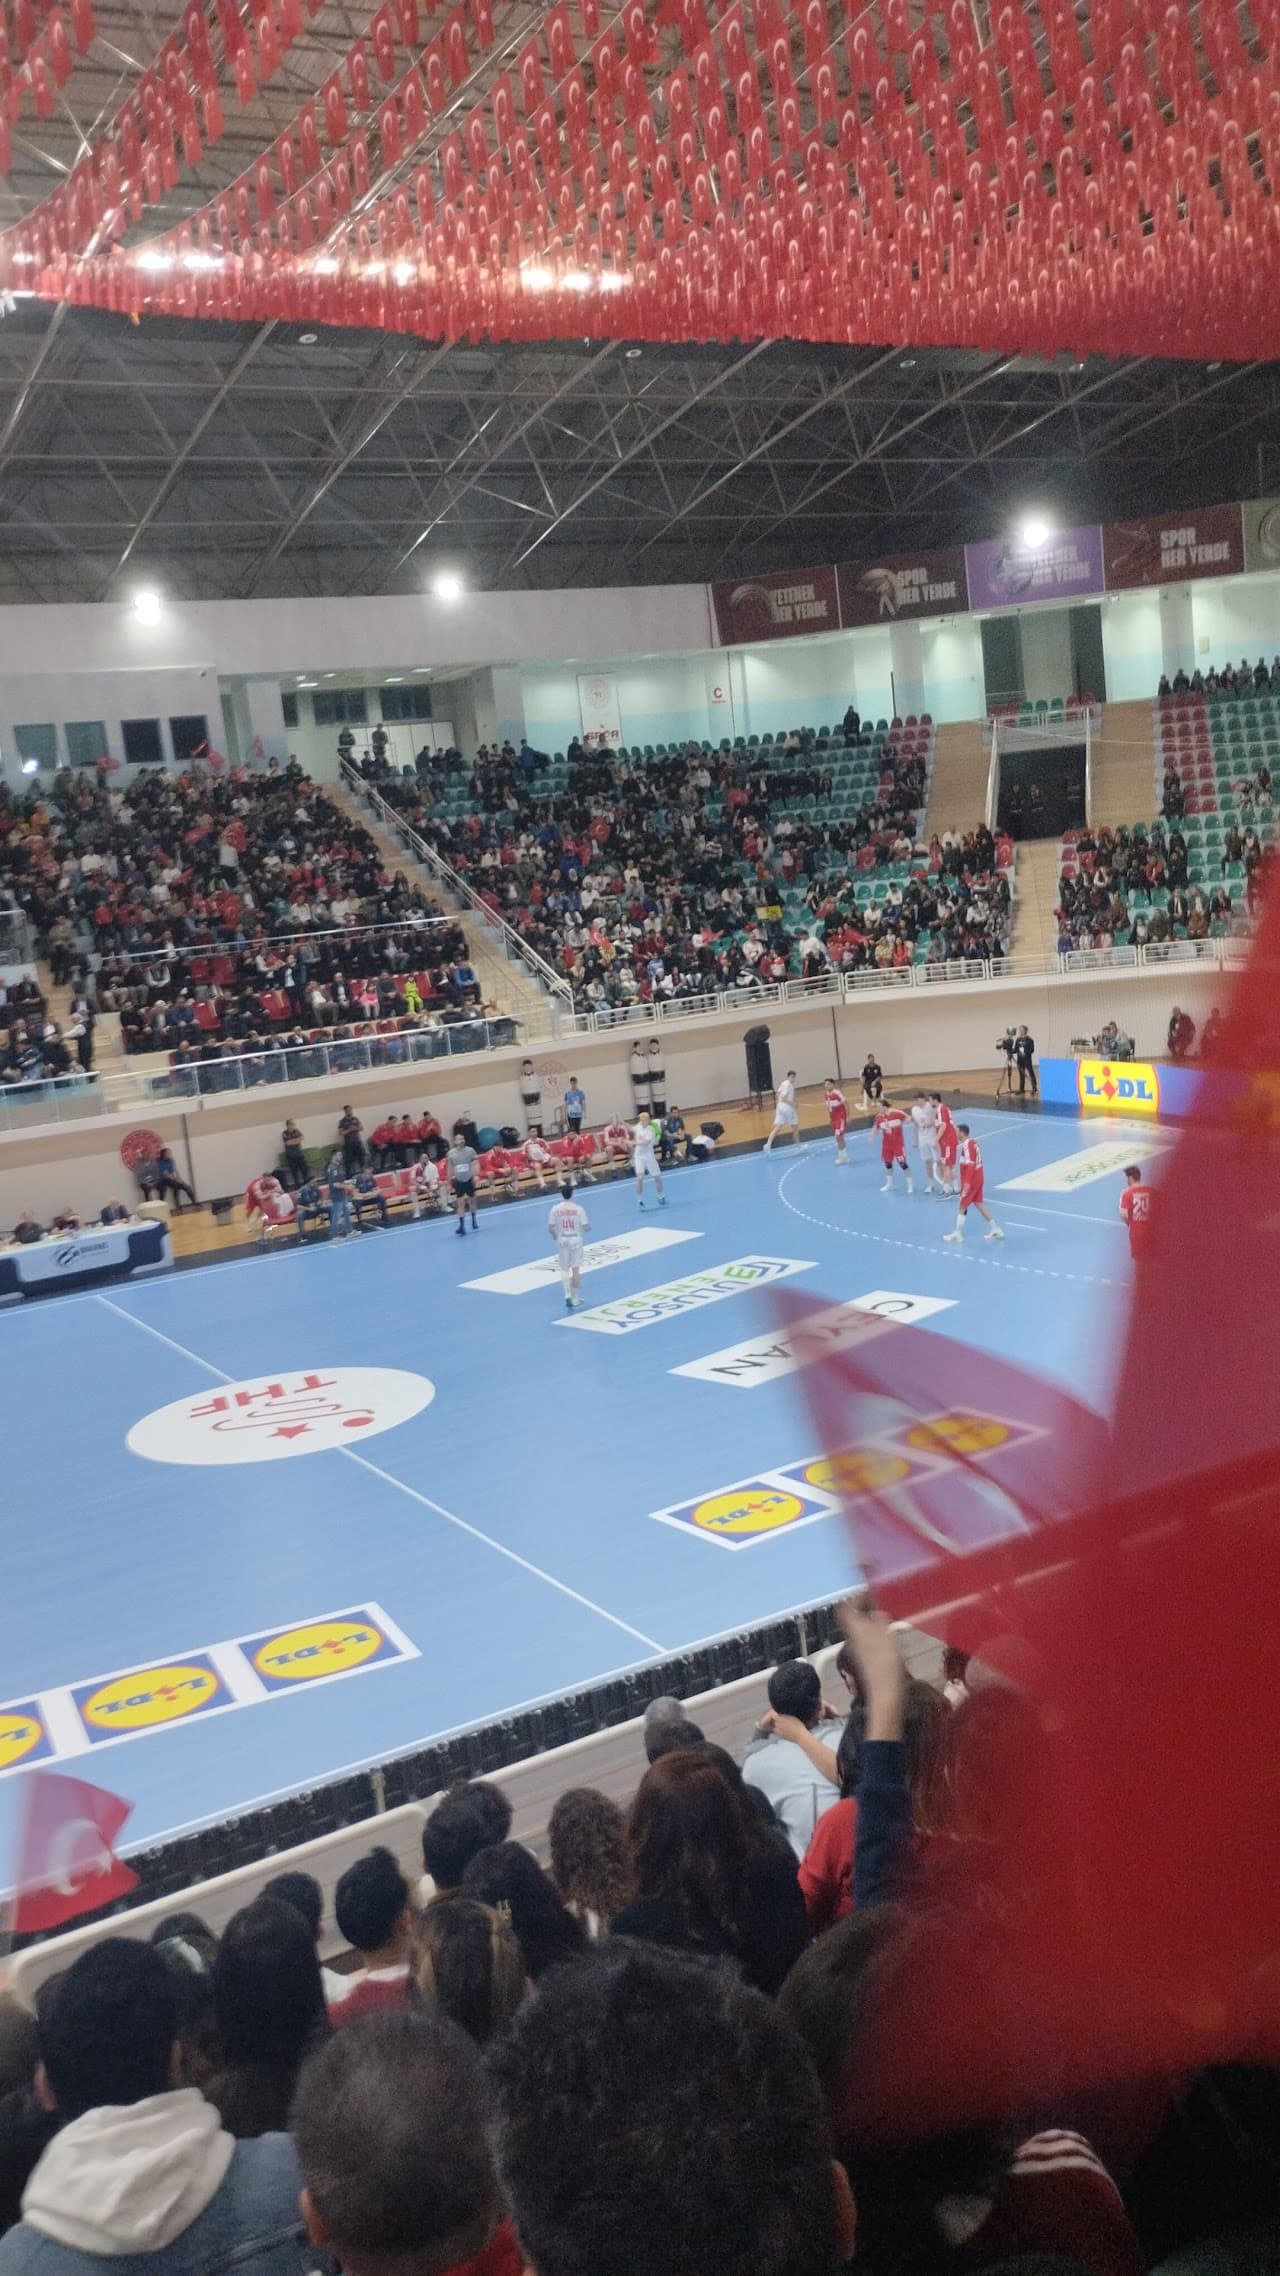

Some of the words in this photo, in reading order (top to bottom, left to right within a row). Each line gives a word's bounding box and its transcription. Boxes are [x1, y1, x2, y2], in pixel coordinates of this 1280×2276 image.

[1160, 527, 1196, 548] SPOR
[1161, 547, 1187, 568] HER
[1189, 541, 1229, 564] YERDE
[897, 568, 928, 588] SPOR
[922, 581, 957, 602] YERDE
[794, 600, 829, 621] YERDE
[713, 687, 723, 699] C
[1084, 1066, 1153, 1100] LIDL
[562, 1217, 575, 1231] 44
[608, 1279, 749, 1328] ULUSOY
[190, 1375, 337, 1418] THF
[706, 1496, 790, 1527] LIDL
[265, 1631, 374, 1666] LIDL
[94, 1677, 208, 1715] LIDL
